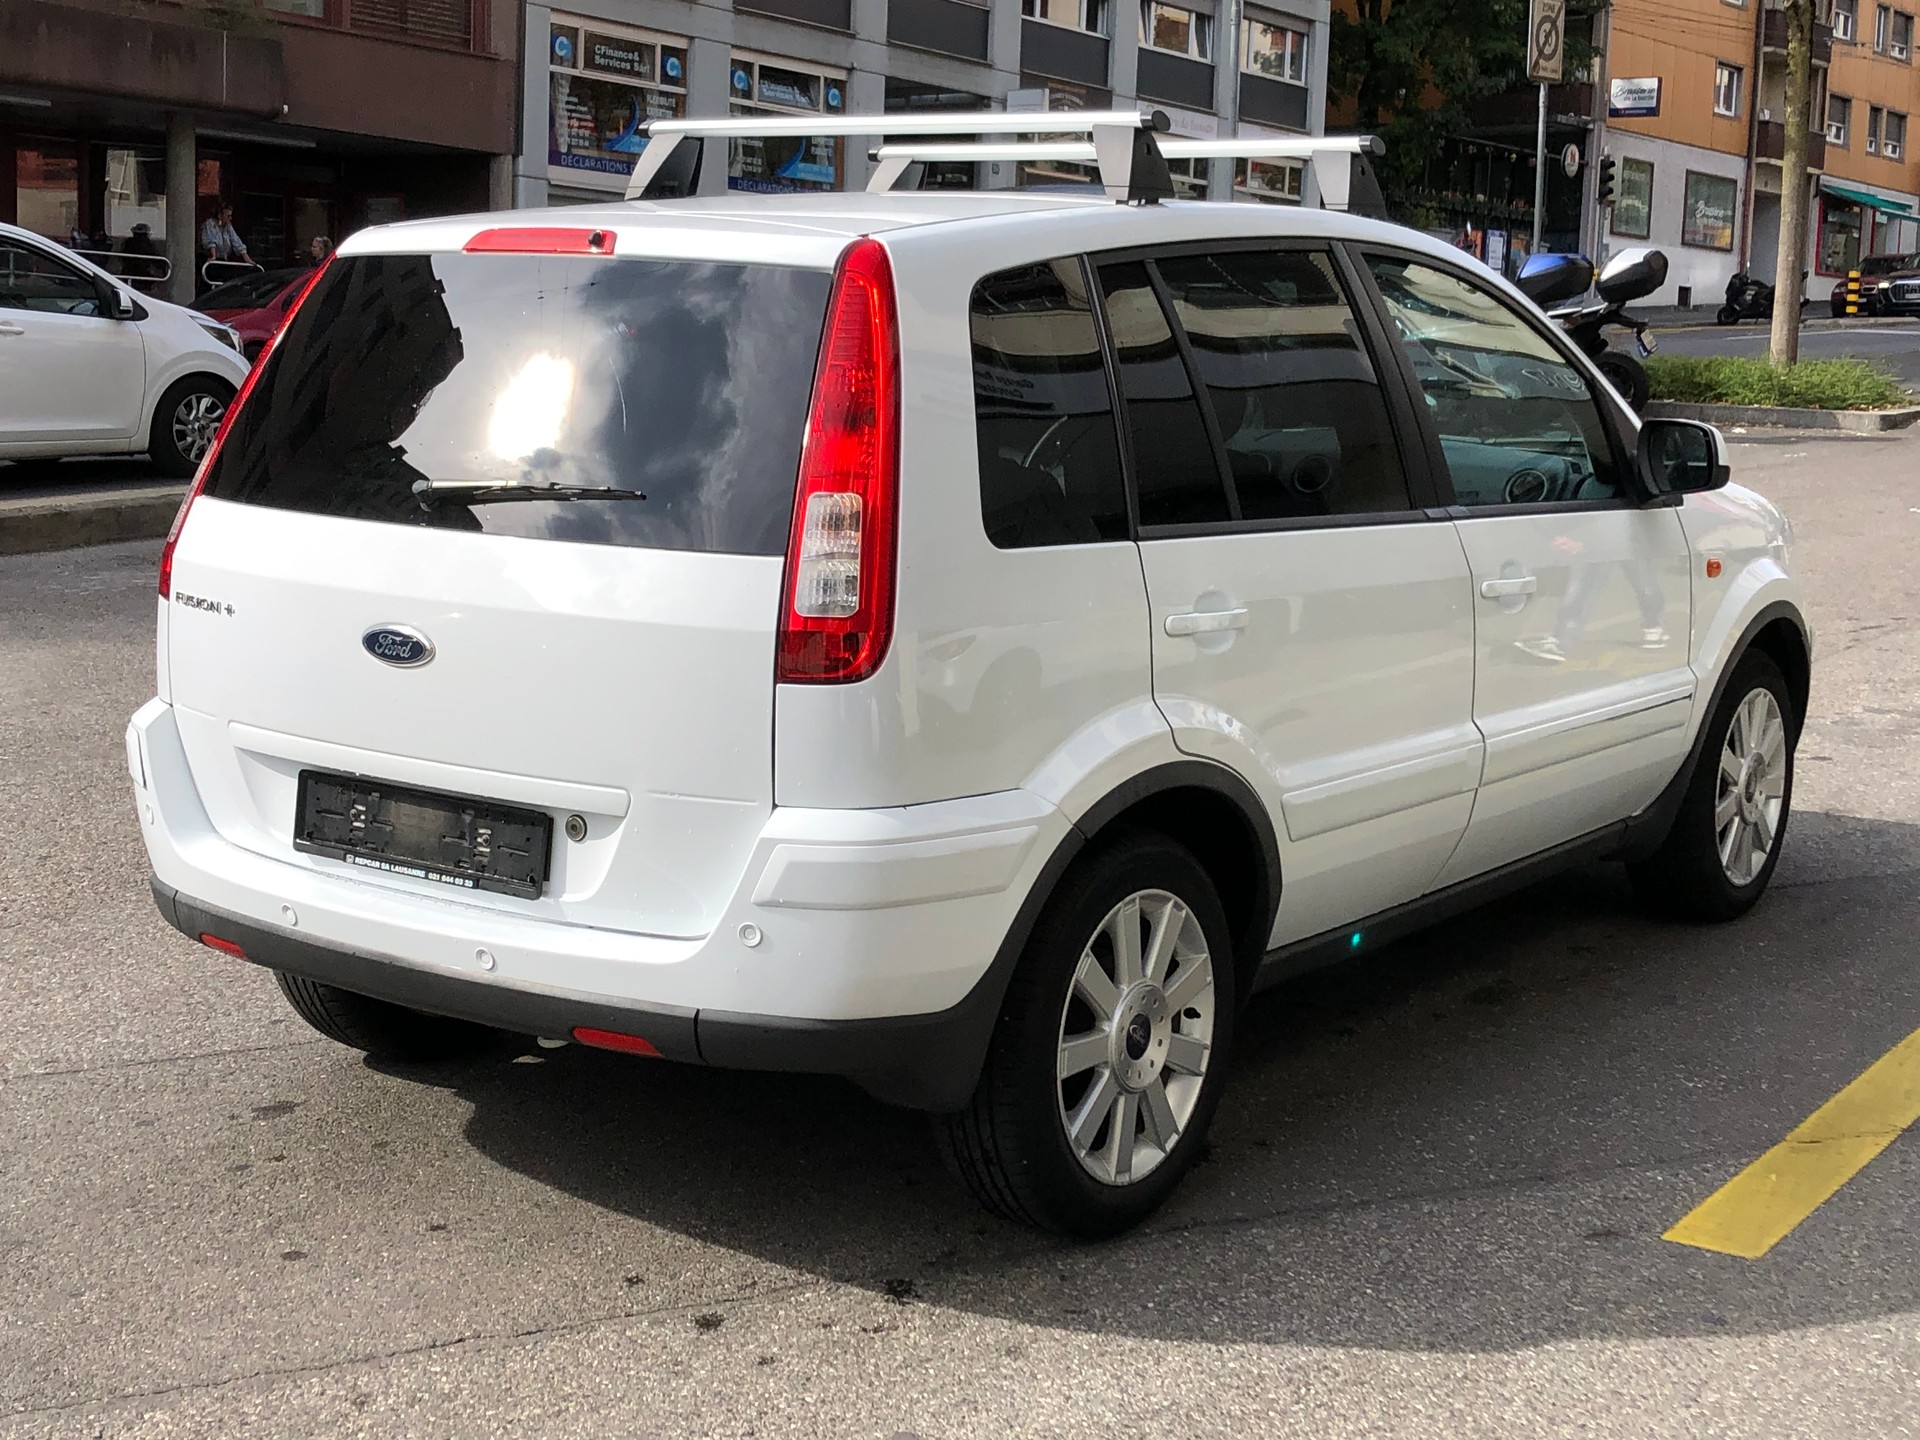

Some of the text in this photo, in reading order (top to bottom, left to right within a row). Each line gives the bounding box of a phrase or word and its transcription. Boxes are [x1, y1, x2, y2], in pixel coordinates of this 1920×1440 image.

[594, 54, 631, 71] Services
[176, 591, 222, 615] FUSION
[374, 633, 412, 658] Ford
[355, 857, 380, 869] REPCAR
[381, 863, 390, 871] SA
[391, 865, 426, 878] LAUSANNE
